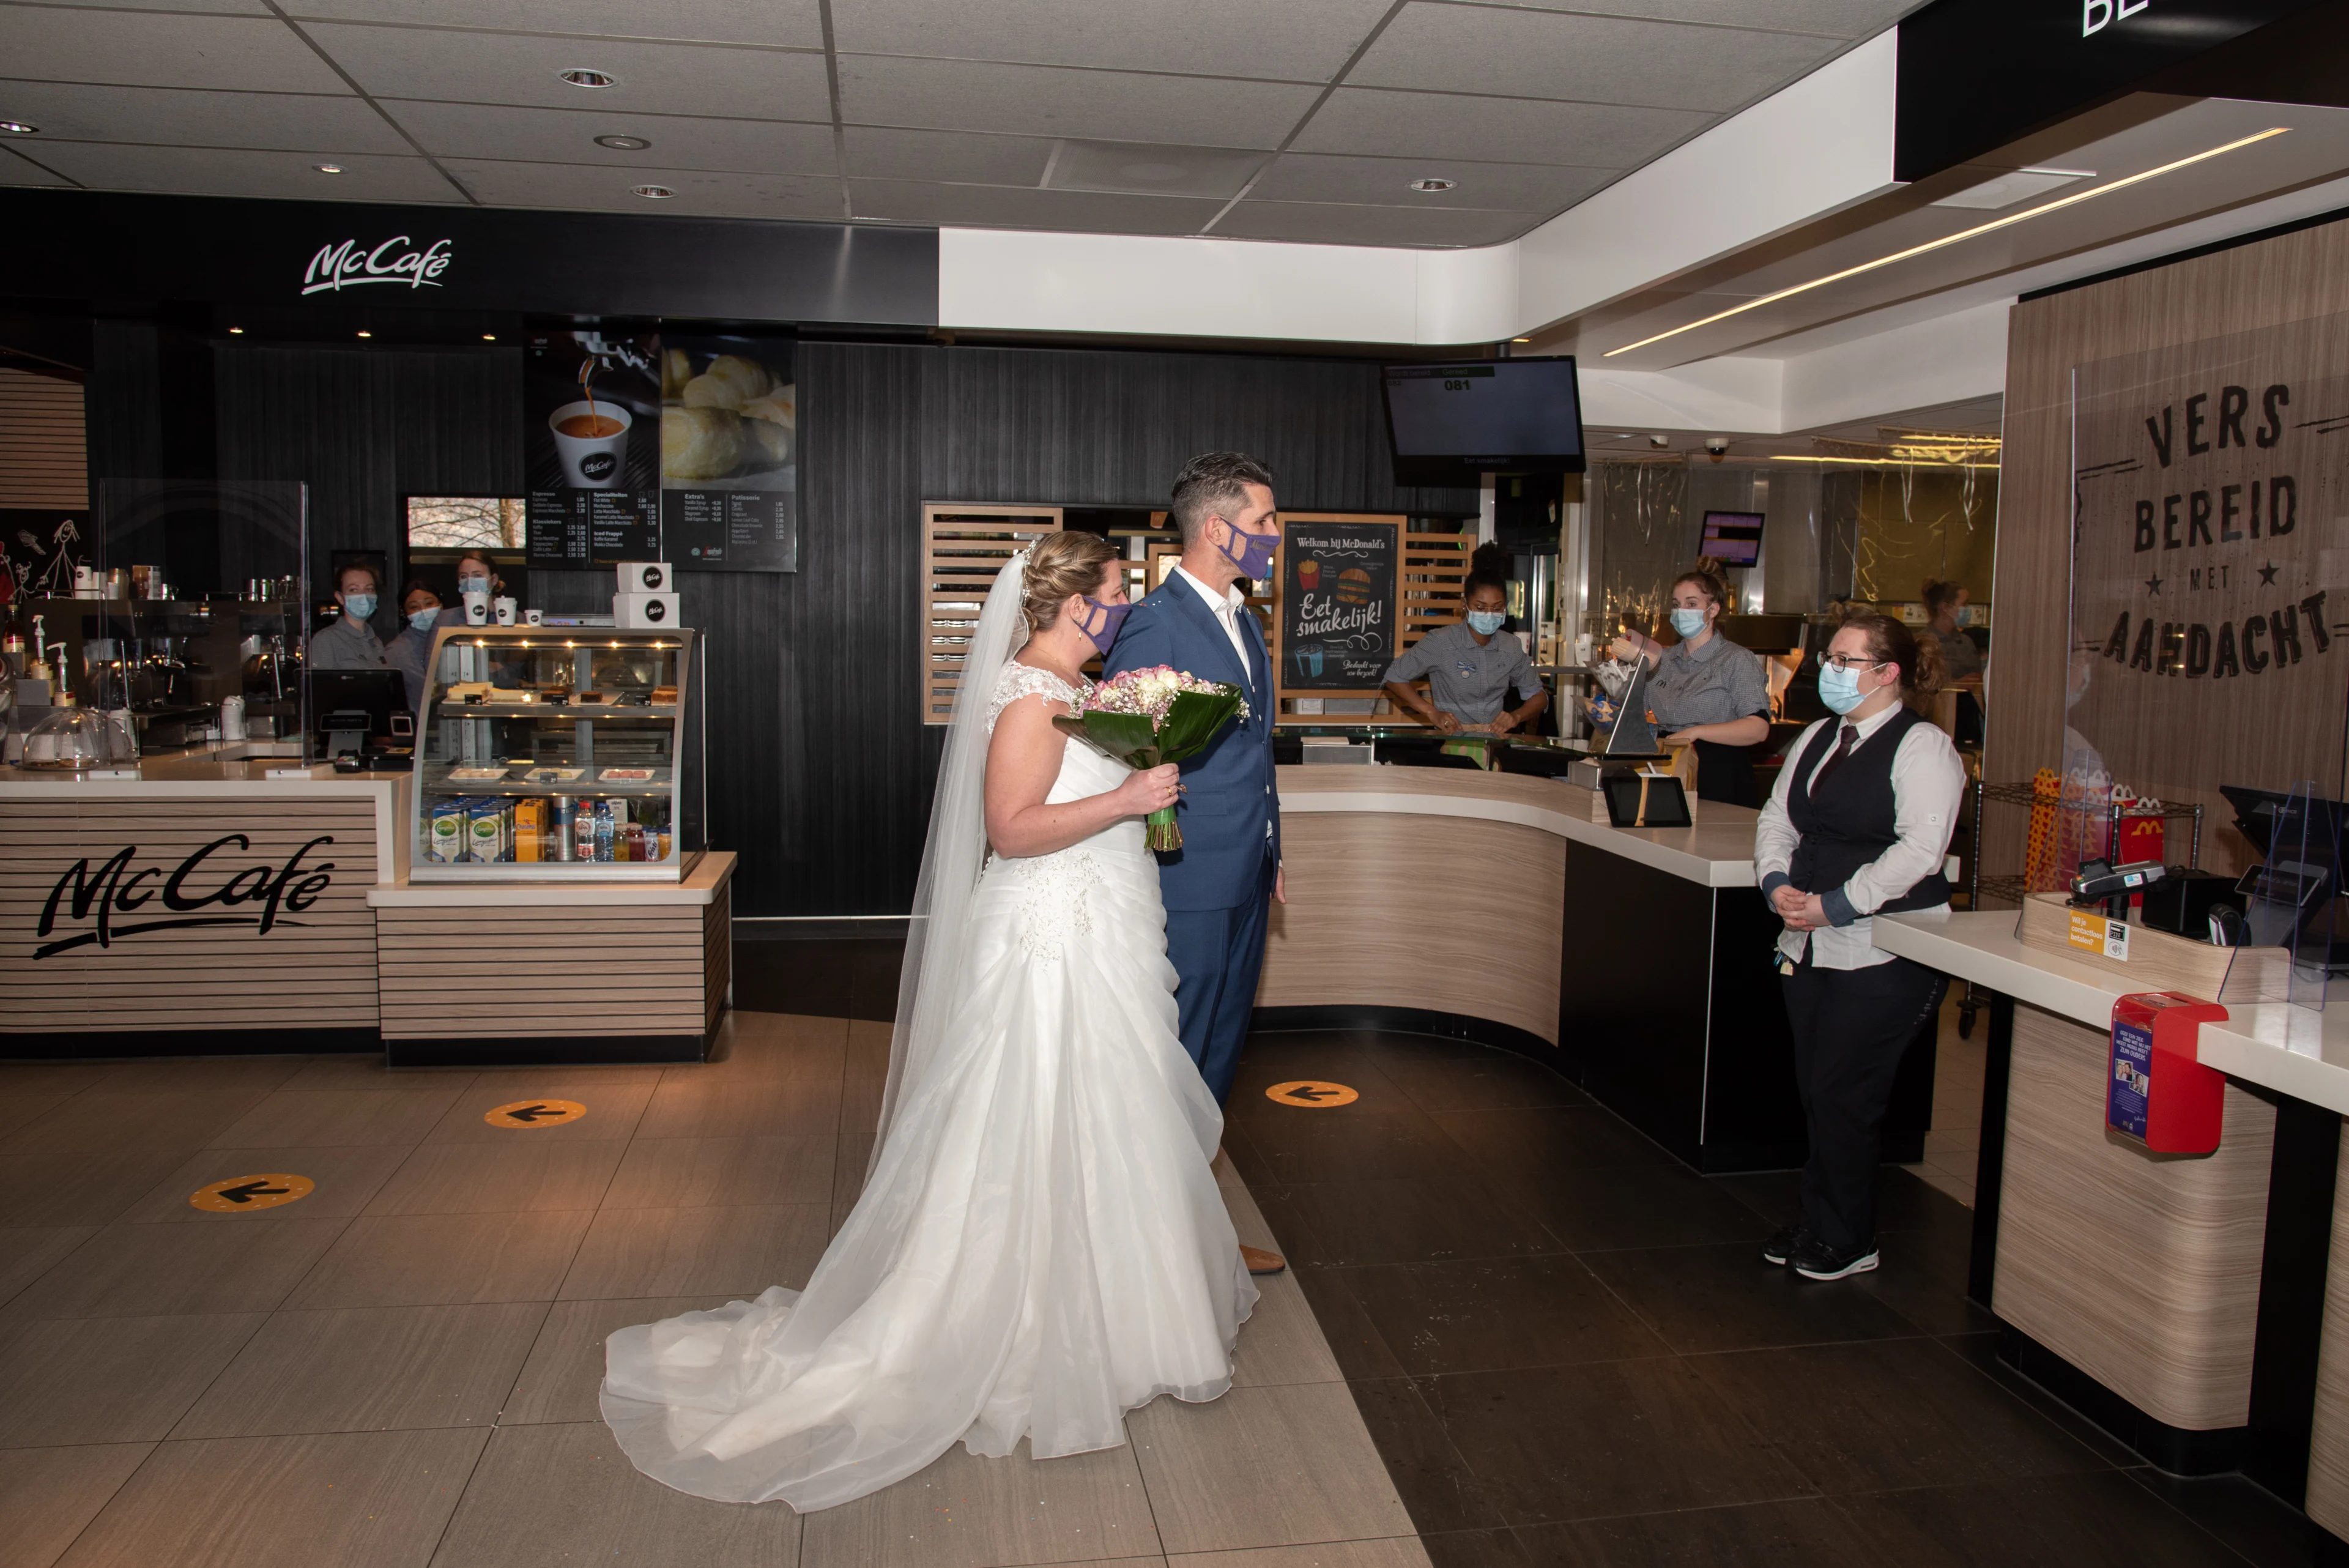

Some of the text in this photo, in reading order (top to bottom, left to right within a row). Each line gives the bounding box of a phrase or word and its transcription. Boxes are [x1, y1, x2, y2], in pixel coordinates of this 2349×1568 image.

[302, 236, 451, 295] McCafé
[1444, 379, 1470, 391] 081
[2145, 384, 2290, 468] VERS
[584, 459, 615, 474] McCafé
[2134, 475, 2296, 553] BEREID
[1297, 537, 1385, 549] Welkom bij McDonald's
[2190, 565, 2229, 592] MET
[1299, 593, 1331, 620] Eet
[1296, 600, 1382, 637] smakelijk!
[2103, 590, 2329, 679] AANDACHT
[1343, 660, 1368, 670] Bedankt
[1356, 668, 1377, 678] bezoek!
[647, 840, 657, 858] Fristi
[32, 834, 335, 960] McCafé
[2080, 918, 2087, 927] je
[2071, 926, 2103, 939] contactloos
[2071, 933, 2093, 945] betalen?
[2120, 1046, 2129, 1055] ZIJN
